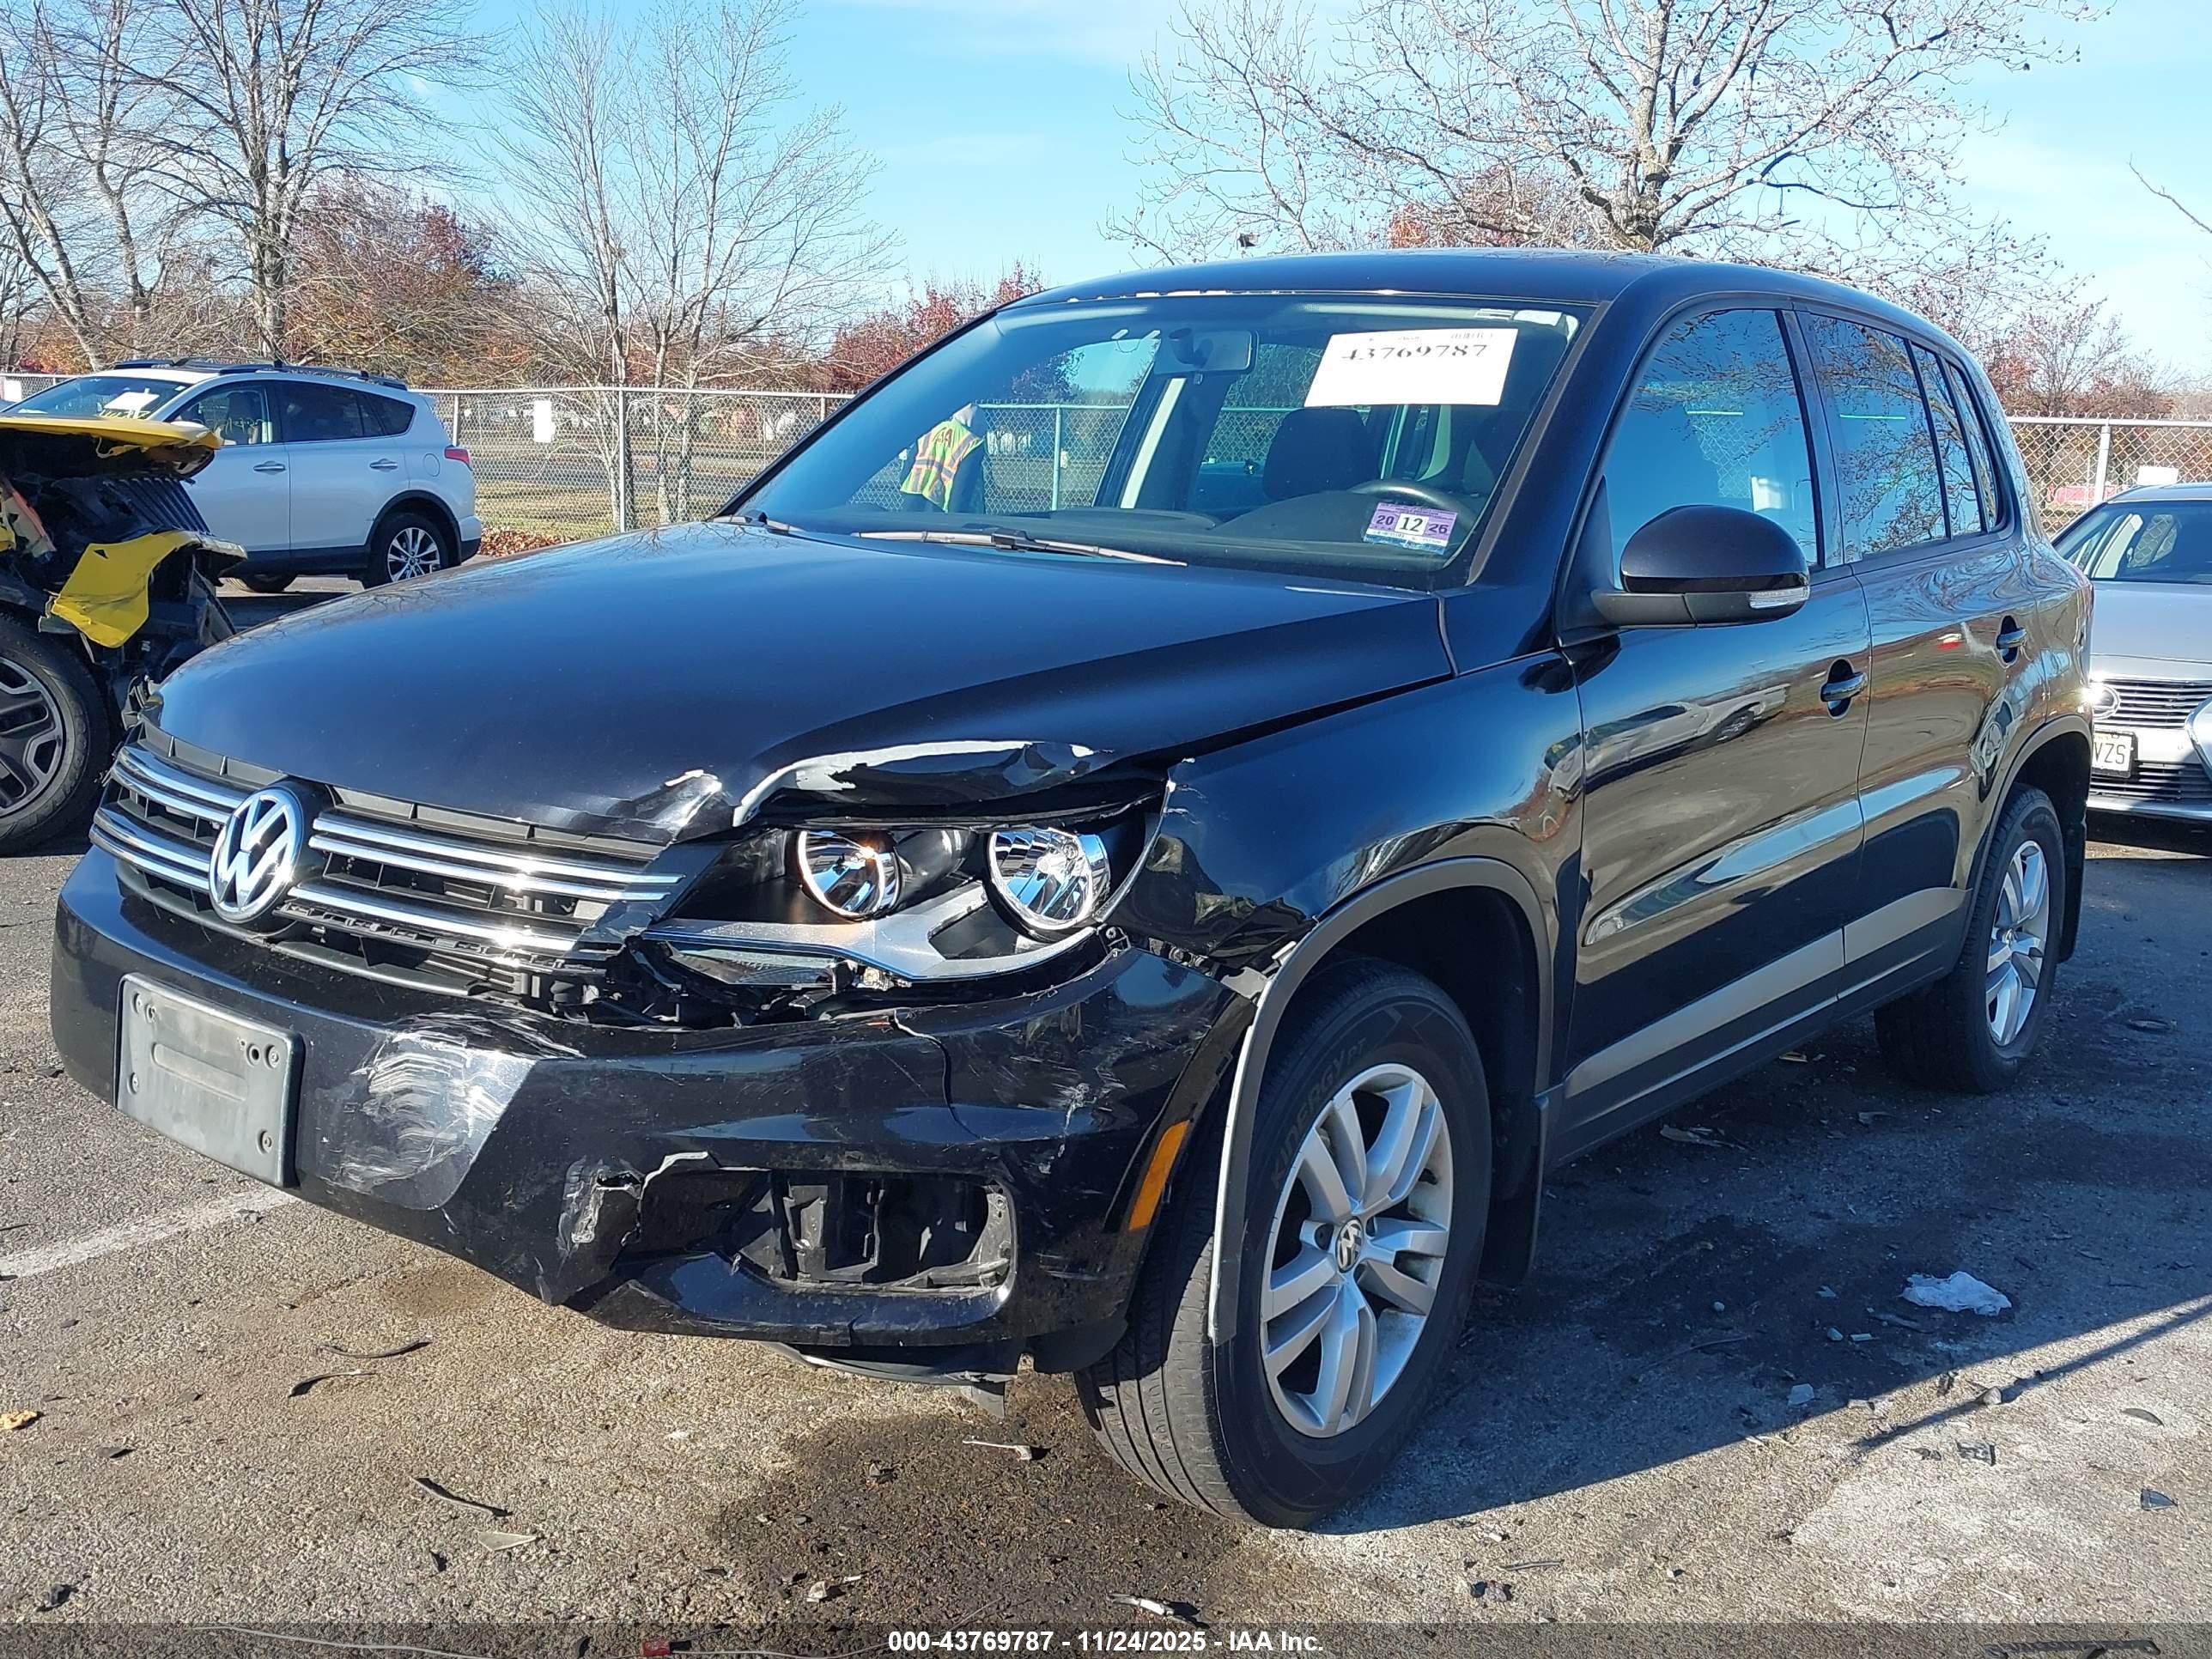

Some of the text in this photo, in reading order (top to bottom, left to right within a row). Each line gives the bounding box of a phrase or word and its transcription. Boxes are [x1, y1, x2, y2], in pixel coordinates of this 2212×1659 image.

[1340, 344, 1488, 361] 43769787
[1376, 514, 1449, 534] 20 12 26
